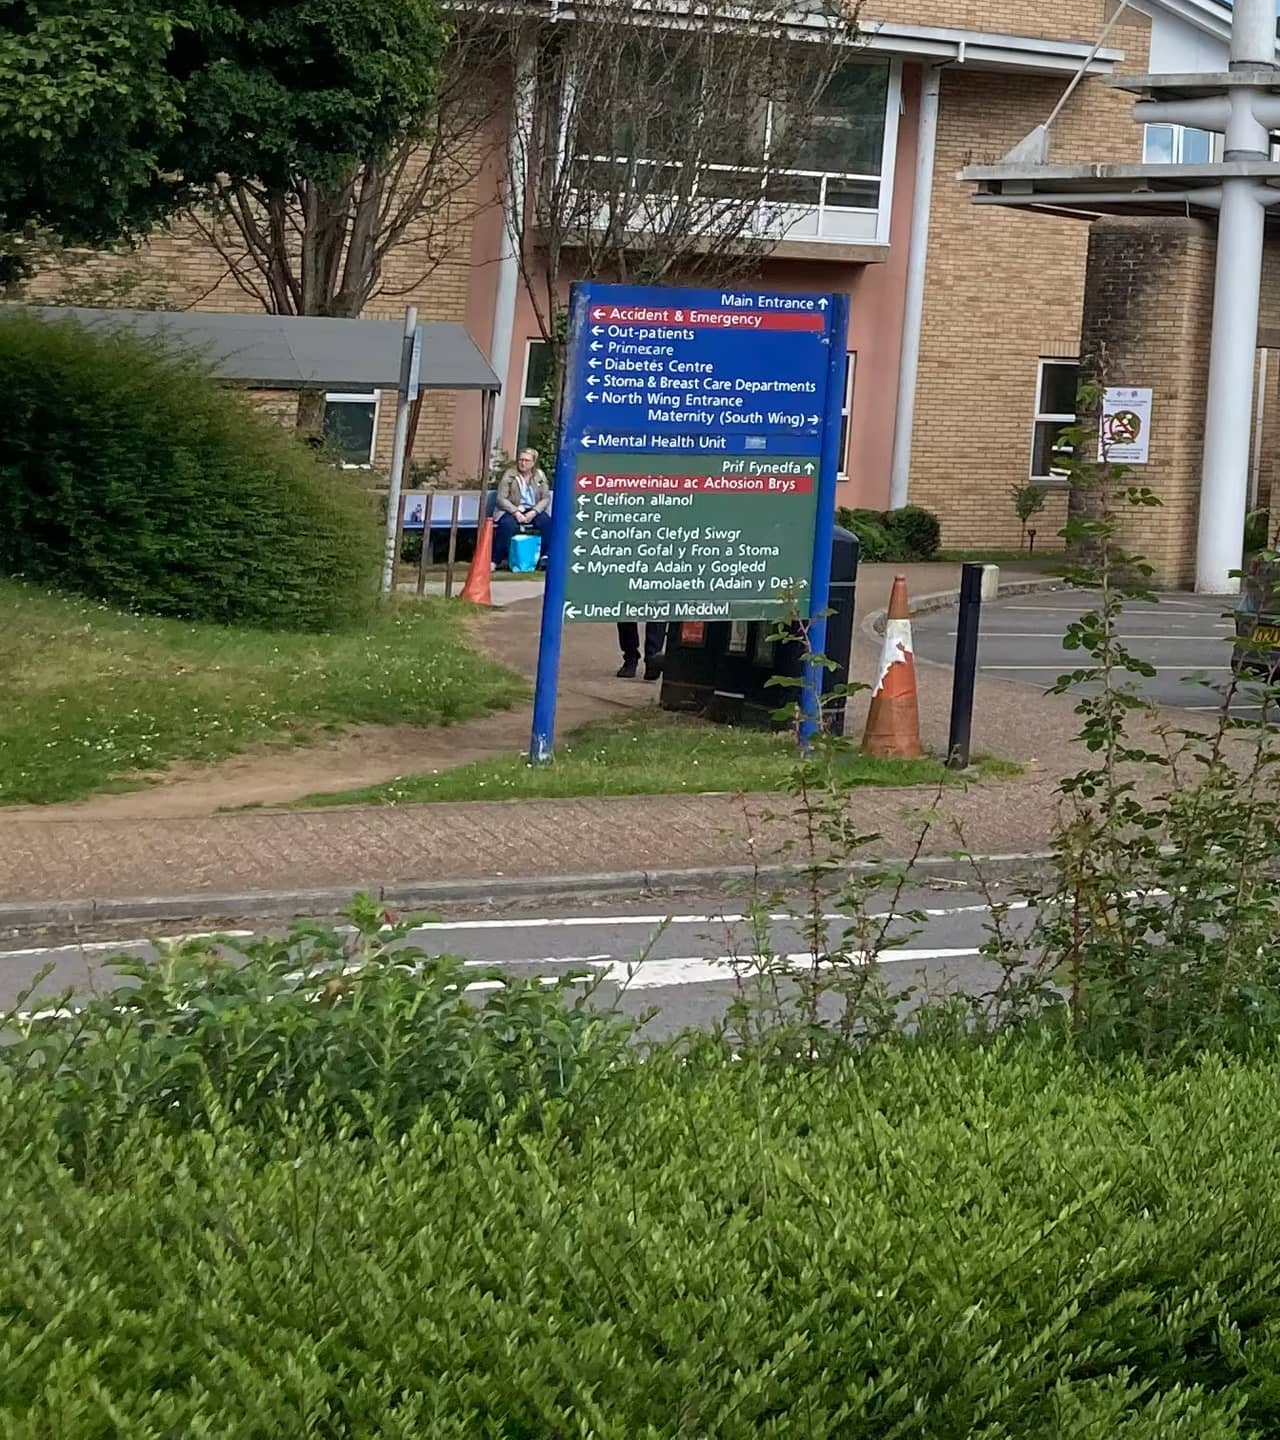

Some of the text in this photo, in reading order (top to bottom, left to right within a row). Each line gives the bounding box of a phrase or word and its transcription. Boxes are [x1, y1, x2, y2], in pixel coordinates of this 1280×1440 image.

[722, 294, 813, 309] Main Entrance
[610, 308, 761, 327] Accident & Emergency
[608, 326, 694, 340] Out-patients
[609, 342, 673, 355] Primecare
[605, 359, 713, 372] Diabetes Centre
[603, 375, 816, 393] Stoma & Breast Care Departments
[602, 392, 743, 408] North Wing Entrance
[648, 410, 805, 427] Maternity (South Wing)
[598, 434, 726, 448] Mental Health Unit
[723, 461, 800, 475] Prif Fynedfa
[596, 476, 795, 492] Damweiniau ac Achosion Brys
[594, 493, 693, 505] Cleifion allanol
[595, 511, 661, 522] Primecare
[591, 528, 741, 542] Canolfan Clefyd Siwgr
[591, 544, 779, 558] Adran Gofal y Fron a Stoma
[588, 560, 766, 575] Mynedfa Adain y Gogledd
[629, 577, 704, 589] Mamolaeth
[710, 577, 752, 591] (Adain
[757, 580, 765, 591] y
[584, 603, 729, 617] Uned Iechyd Meddwl
